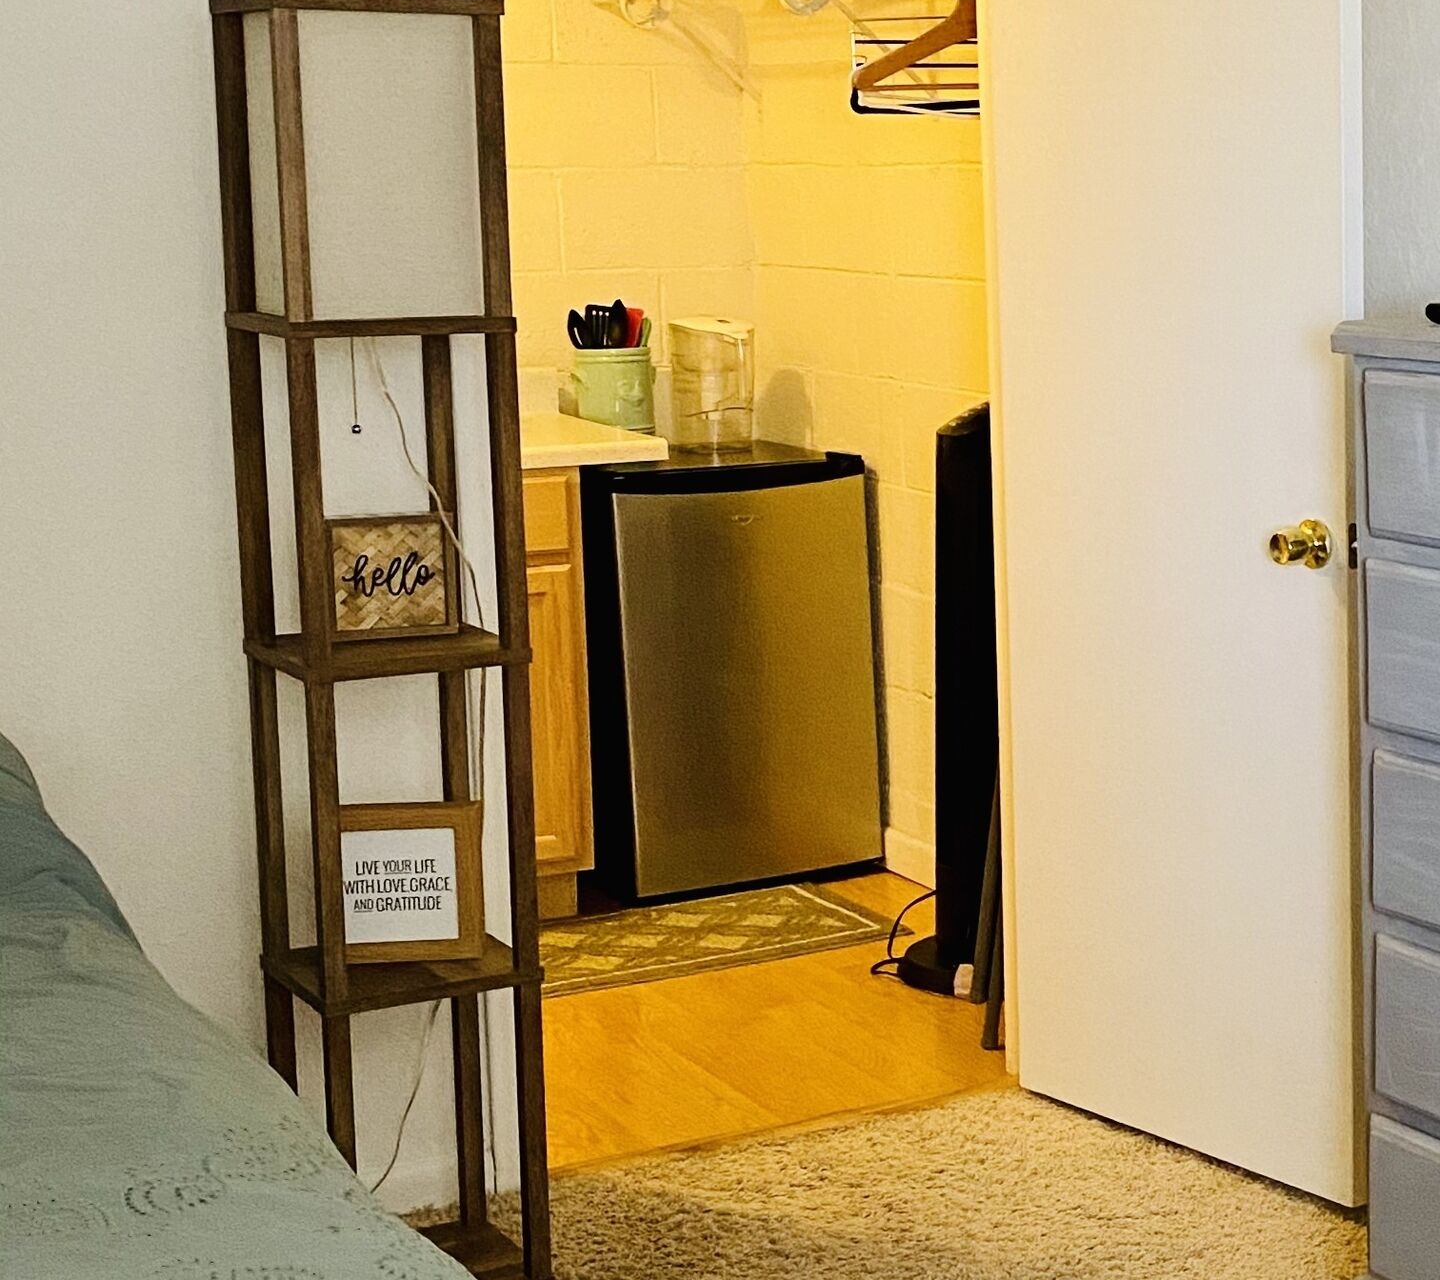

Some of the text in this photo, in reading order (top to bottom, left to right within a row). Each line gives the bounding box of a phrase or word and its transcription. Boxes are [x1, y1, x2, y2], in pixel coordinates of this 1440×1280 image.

[342, 551, 436, 597] hello
[355, 858, 437, 876] LIVE YOUR LIFE
[342, 878, 375, 895] WITH
[353, 895, 443, 913] AND GRATITUDE
